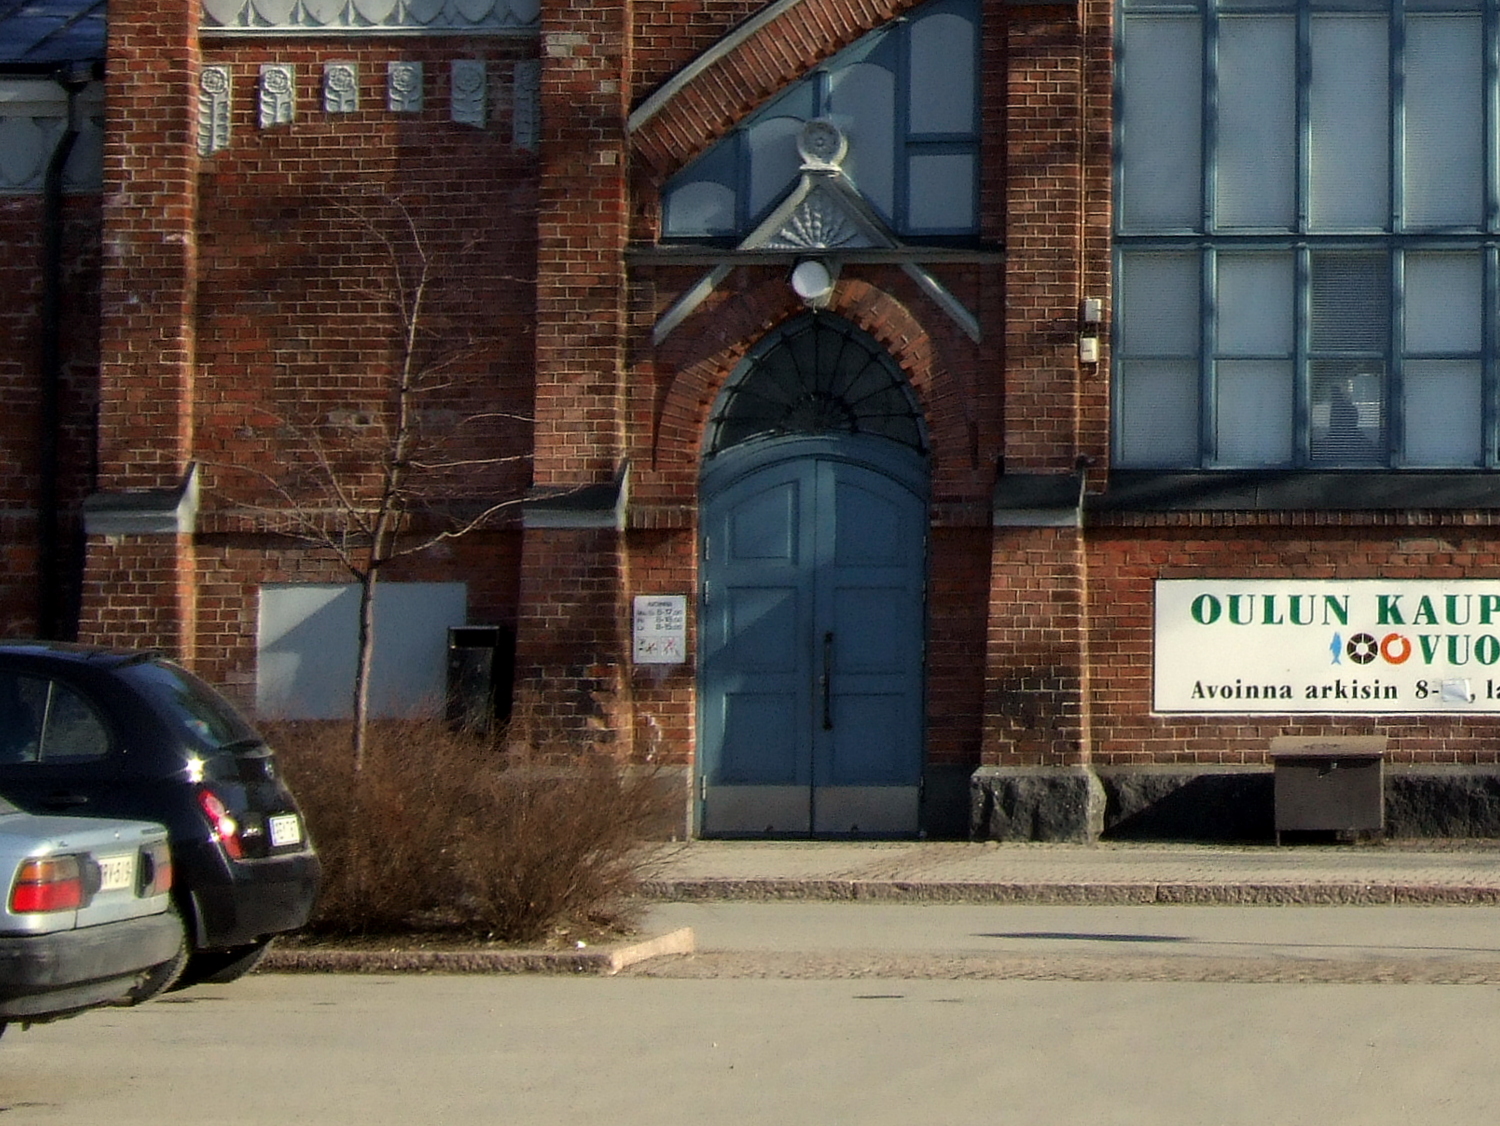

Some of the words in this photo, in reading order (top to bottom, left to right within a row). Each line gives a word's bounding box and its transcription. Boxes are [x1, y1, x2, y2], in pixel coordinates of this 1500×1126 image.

[1191, 593, 1350, 626] OULUN
[1191, 679, 1293, 700] Avoinna
[1305, 679, 1399, 700] arkisin
